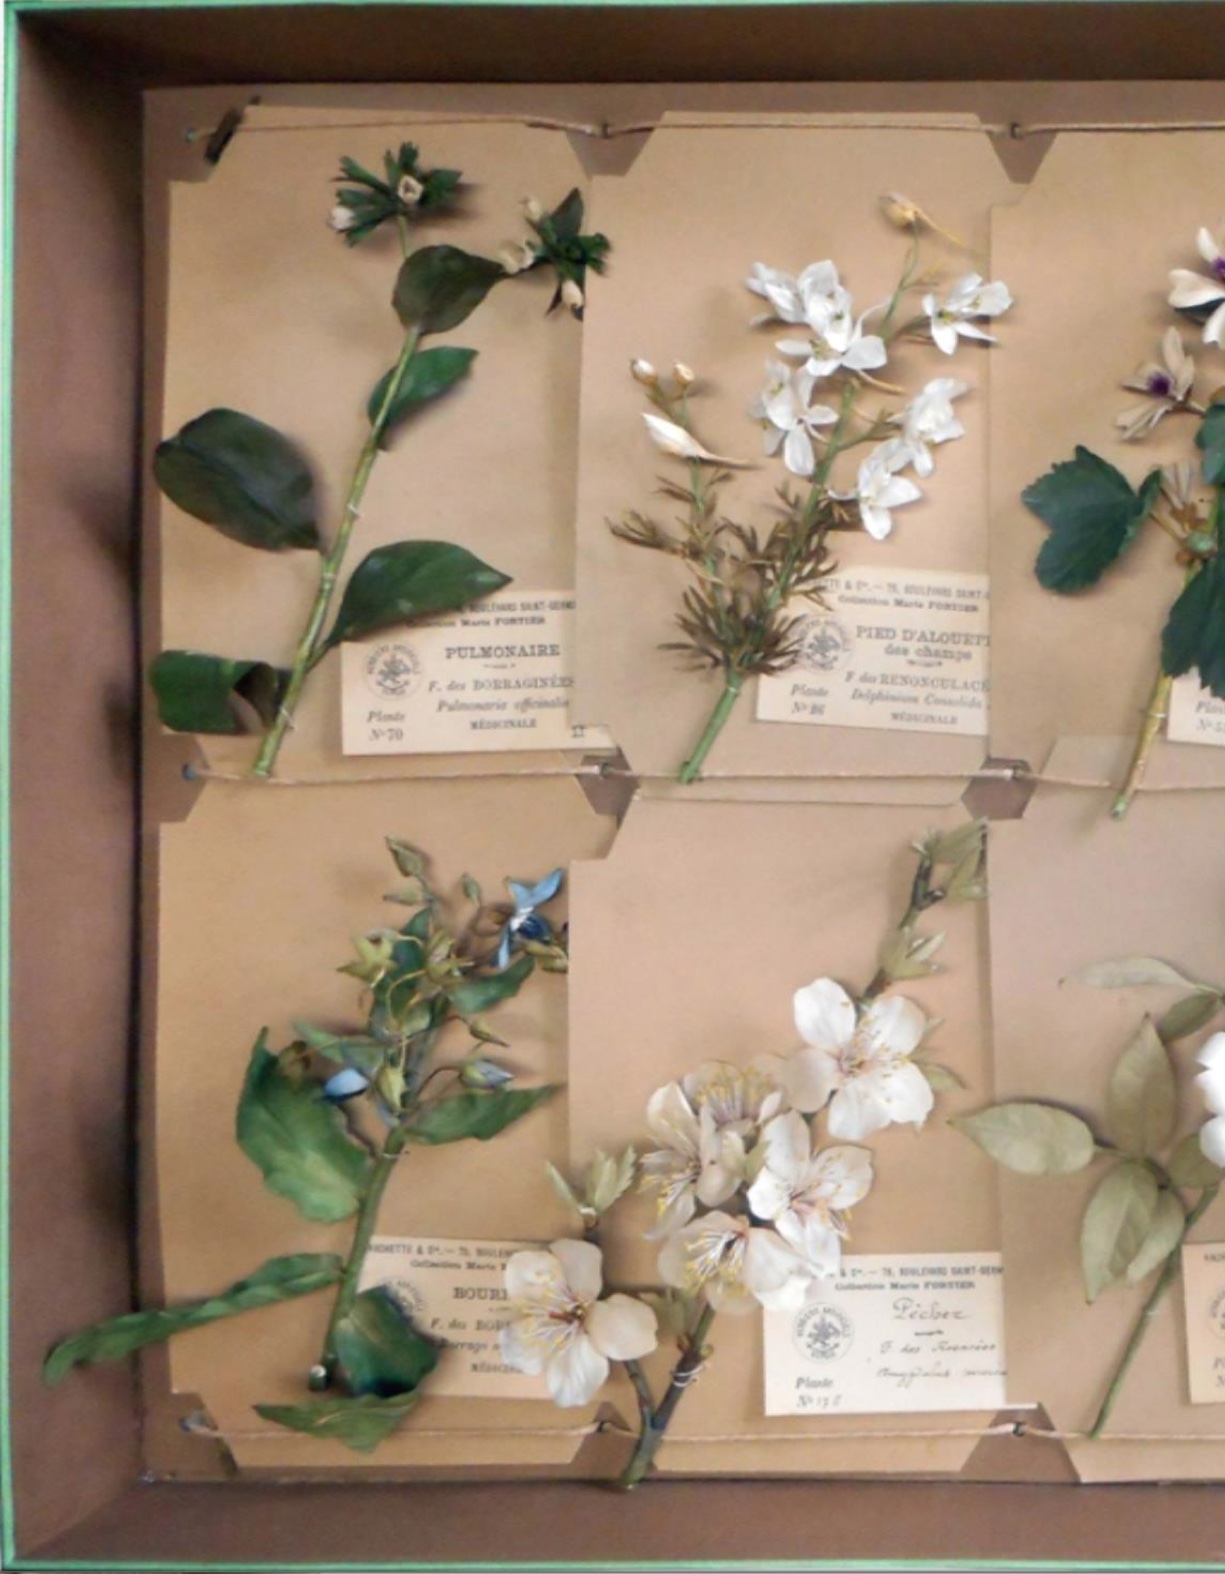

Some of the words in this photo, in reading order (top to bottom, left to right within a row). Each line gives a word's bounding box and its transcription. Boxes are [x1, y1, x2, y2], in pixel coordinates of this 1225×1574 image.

[856, 626, 896, 640] PIED
[445, 644, 561, 659] PULMONAIRE
[885, 645, 908, 656] des
[916, 646, 972, 661] champs
[367, 711, 405, 723] Plante
[924, 1280, 976, 1290] FORTIER
